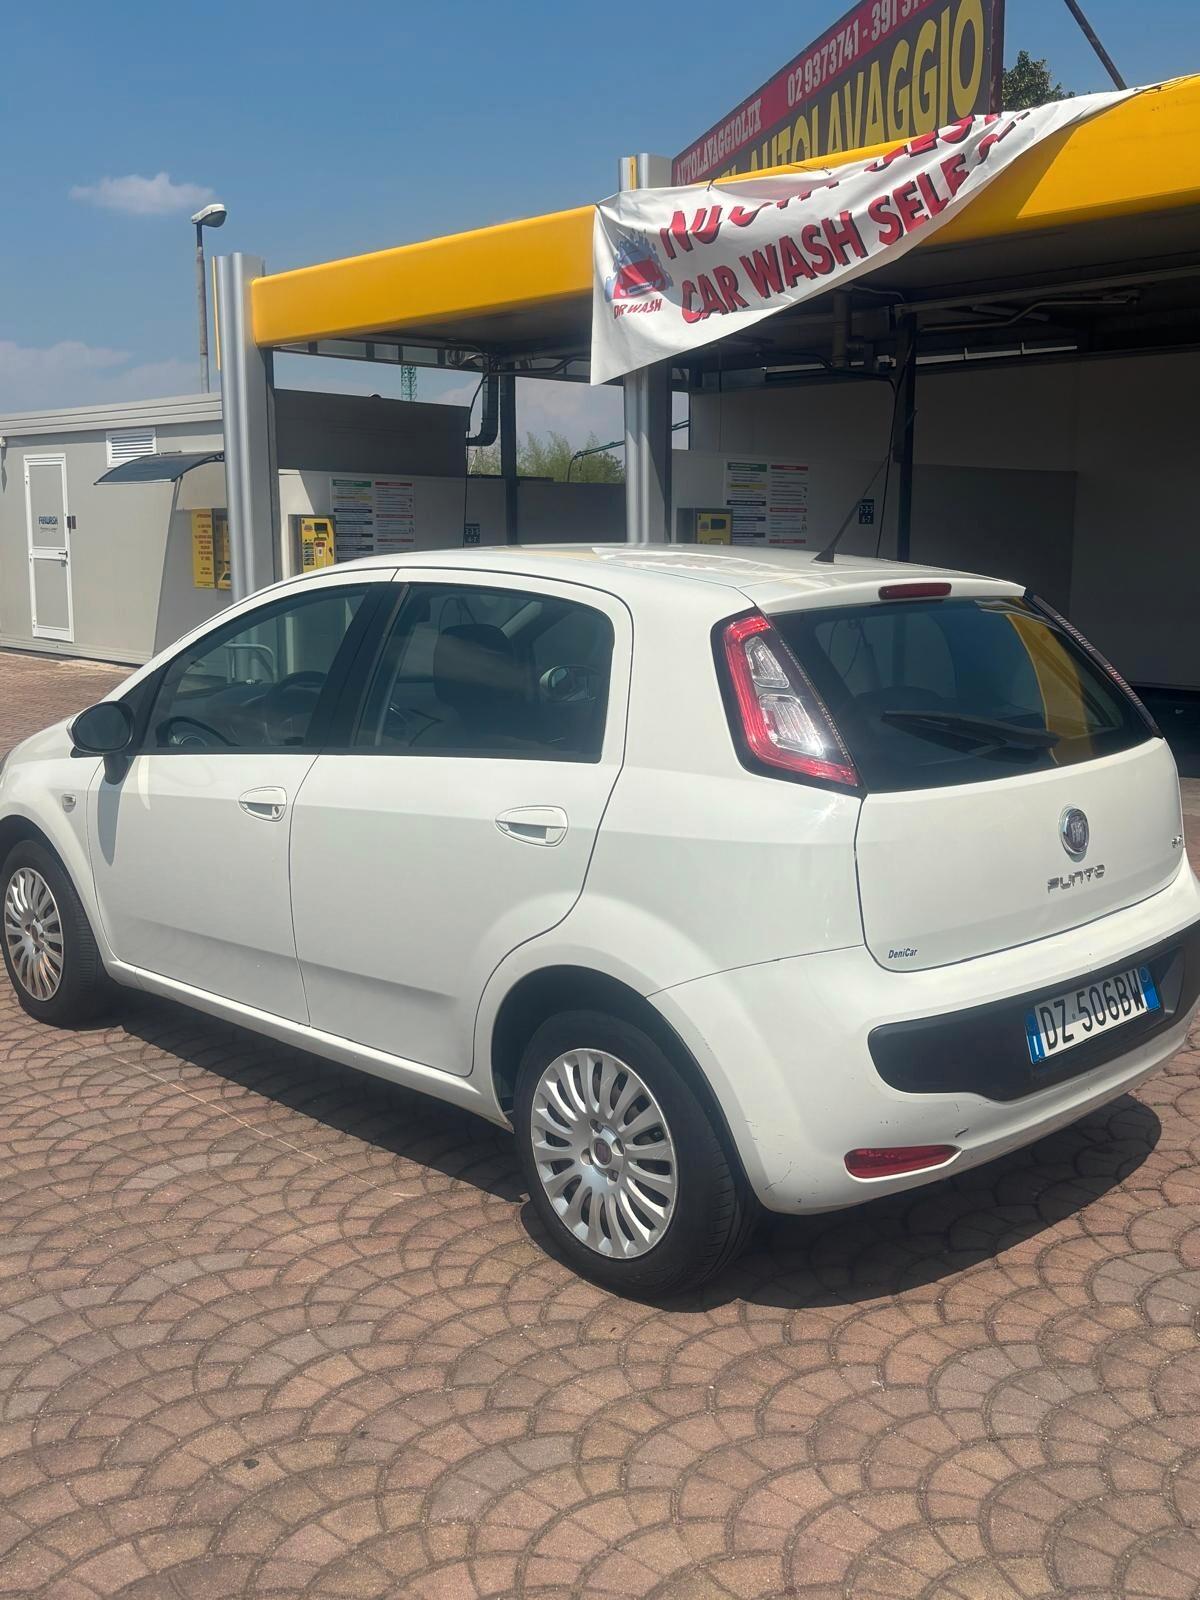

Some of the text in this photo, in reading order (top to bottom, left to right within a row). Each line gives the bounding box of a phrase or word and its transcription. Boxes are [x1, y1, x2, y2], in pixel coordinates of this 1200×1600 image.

[676, 98, 762, 186] AUTOLAVAGGIOLUX
[787, 66, 803, 107] 02
[804, 19, 859, 94] 9373741
[750, 0, 984, 170] TOLAVAGGIO
[627, 298, 663, 314] WASH
[682, 265, 750, 324] CAR
[738, 210, 869, 299] WASH
[1047, 864, 1105, 894] PUNTO
[888, 947, 918, 959] DeniCar
[1039, 998, 1075, 1051] DZ
[1076, 970, 1145, 1033] 506BW
